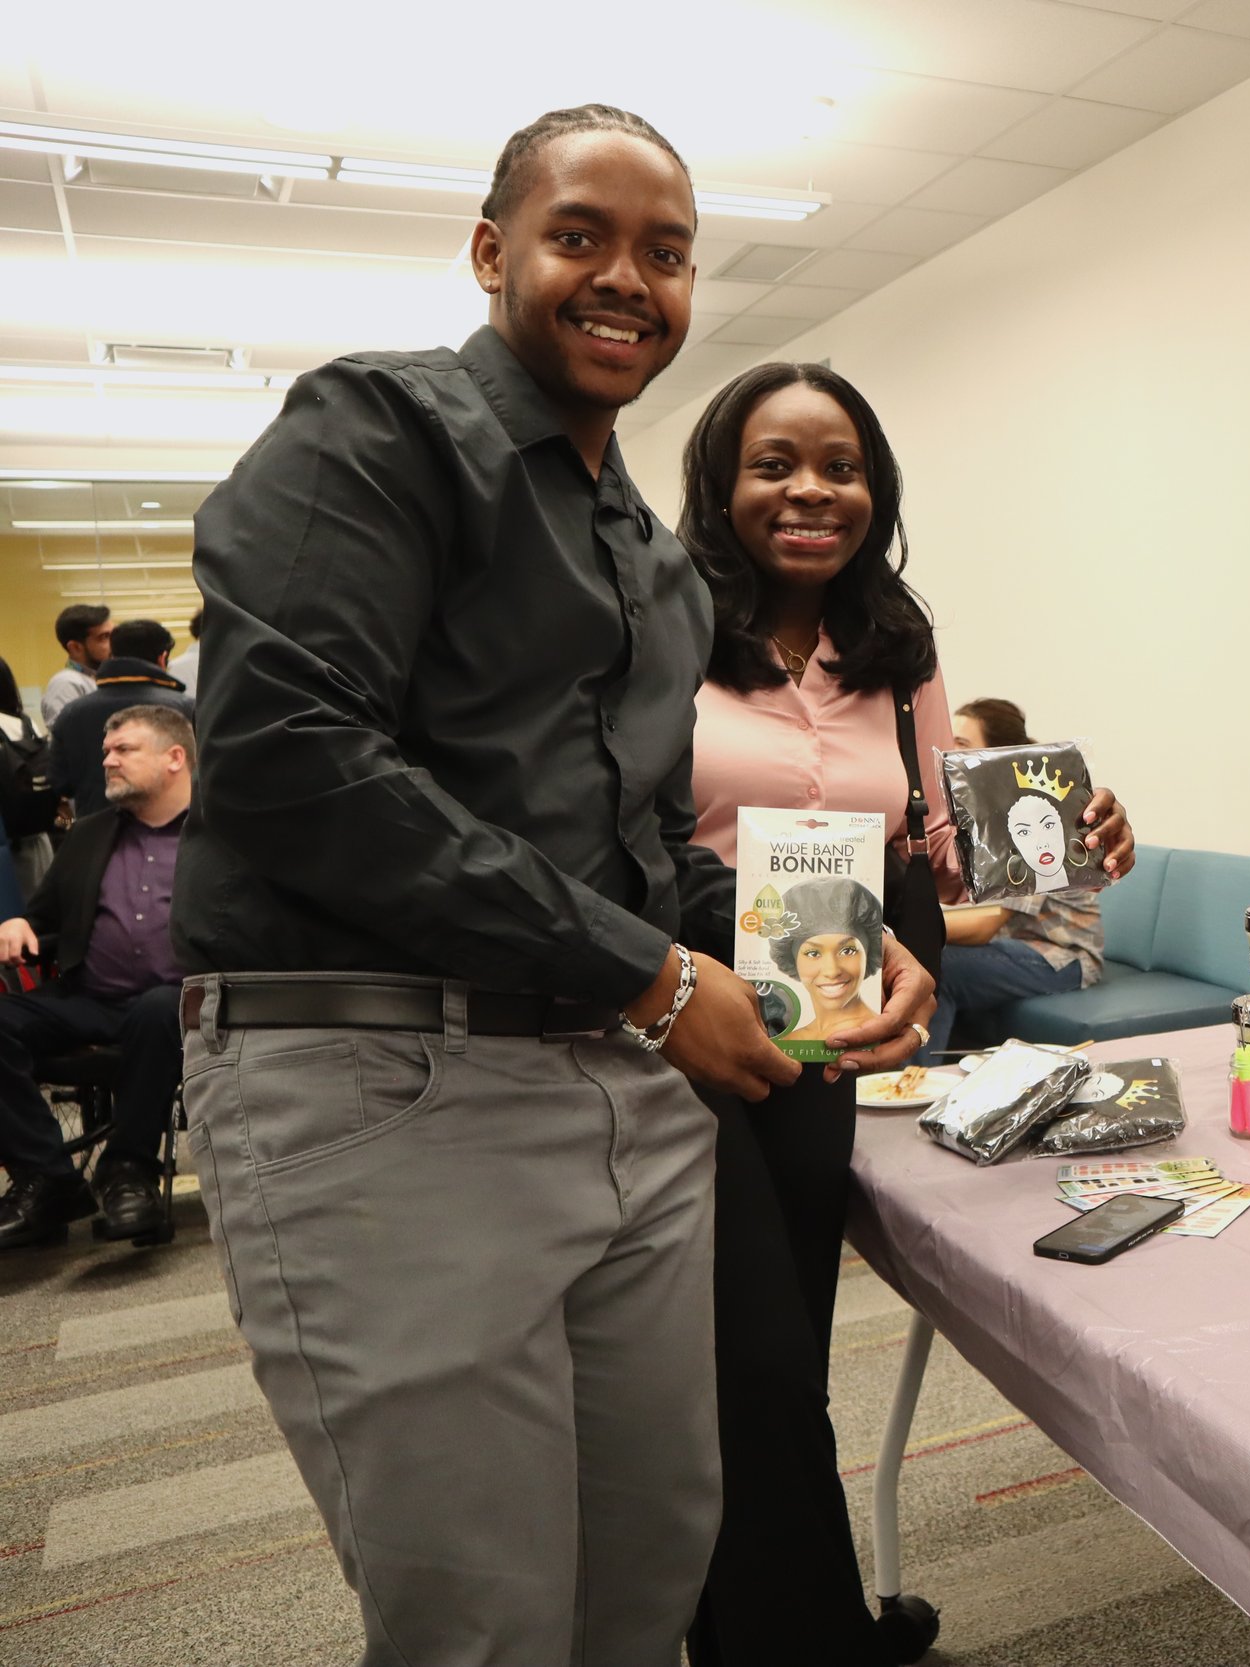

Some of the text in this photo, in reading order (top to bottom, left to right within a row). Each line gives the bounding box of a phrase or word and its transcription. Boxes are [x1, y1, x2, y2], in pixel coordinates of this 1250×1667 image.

[770, 841, 854, 857] WIDE BAND
[771, 856, 854, 874] BONNET
[756, 899, 782, 909] OLIVE
